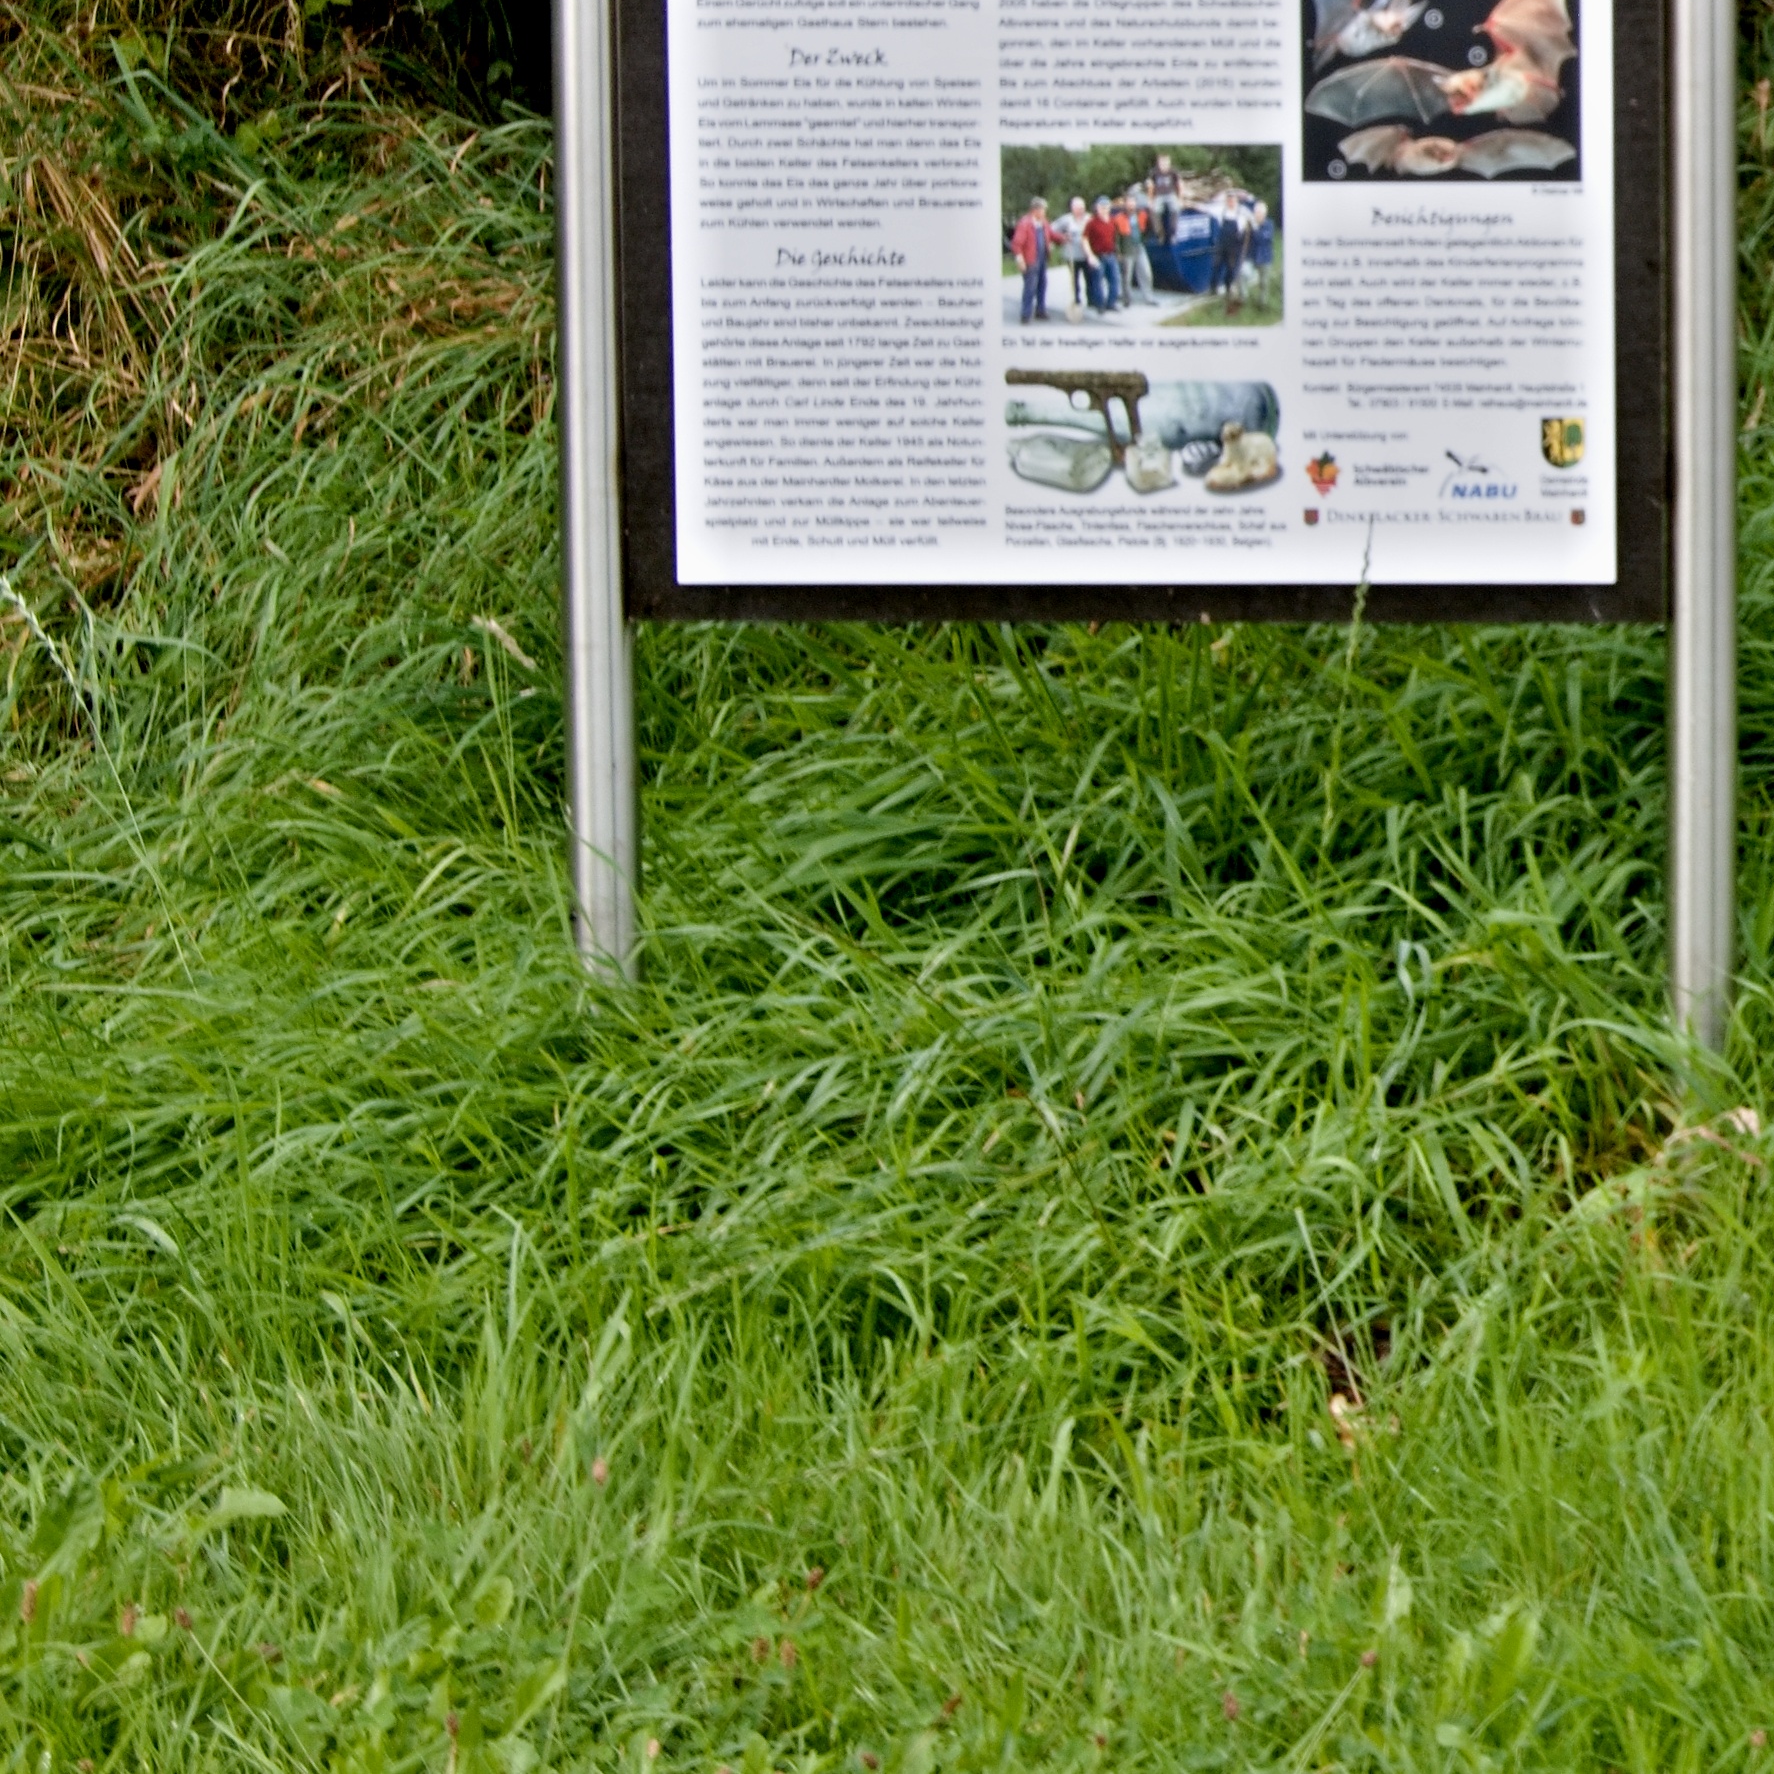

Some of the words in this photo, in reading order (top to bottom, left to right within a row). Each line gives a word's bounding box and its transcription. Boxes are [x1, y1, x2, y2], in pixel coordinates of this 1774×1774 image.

[788, 47, 820, 67] Der
[826, 47, 888, 66] Zweck
[1370, 206, 1513, 235] Besichtigungen
[775, 248, 805, 267] Die
[811, 246, 906, 274] Geschichte
[1451, 483, 1519, 499] NABU
